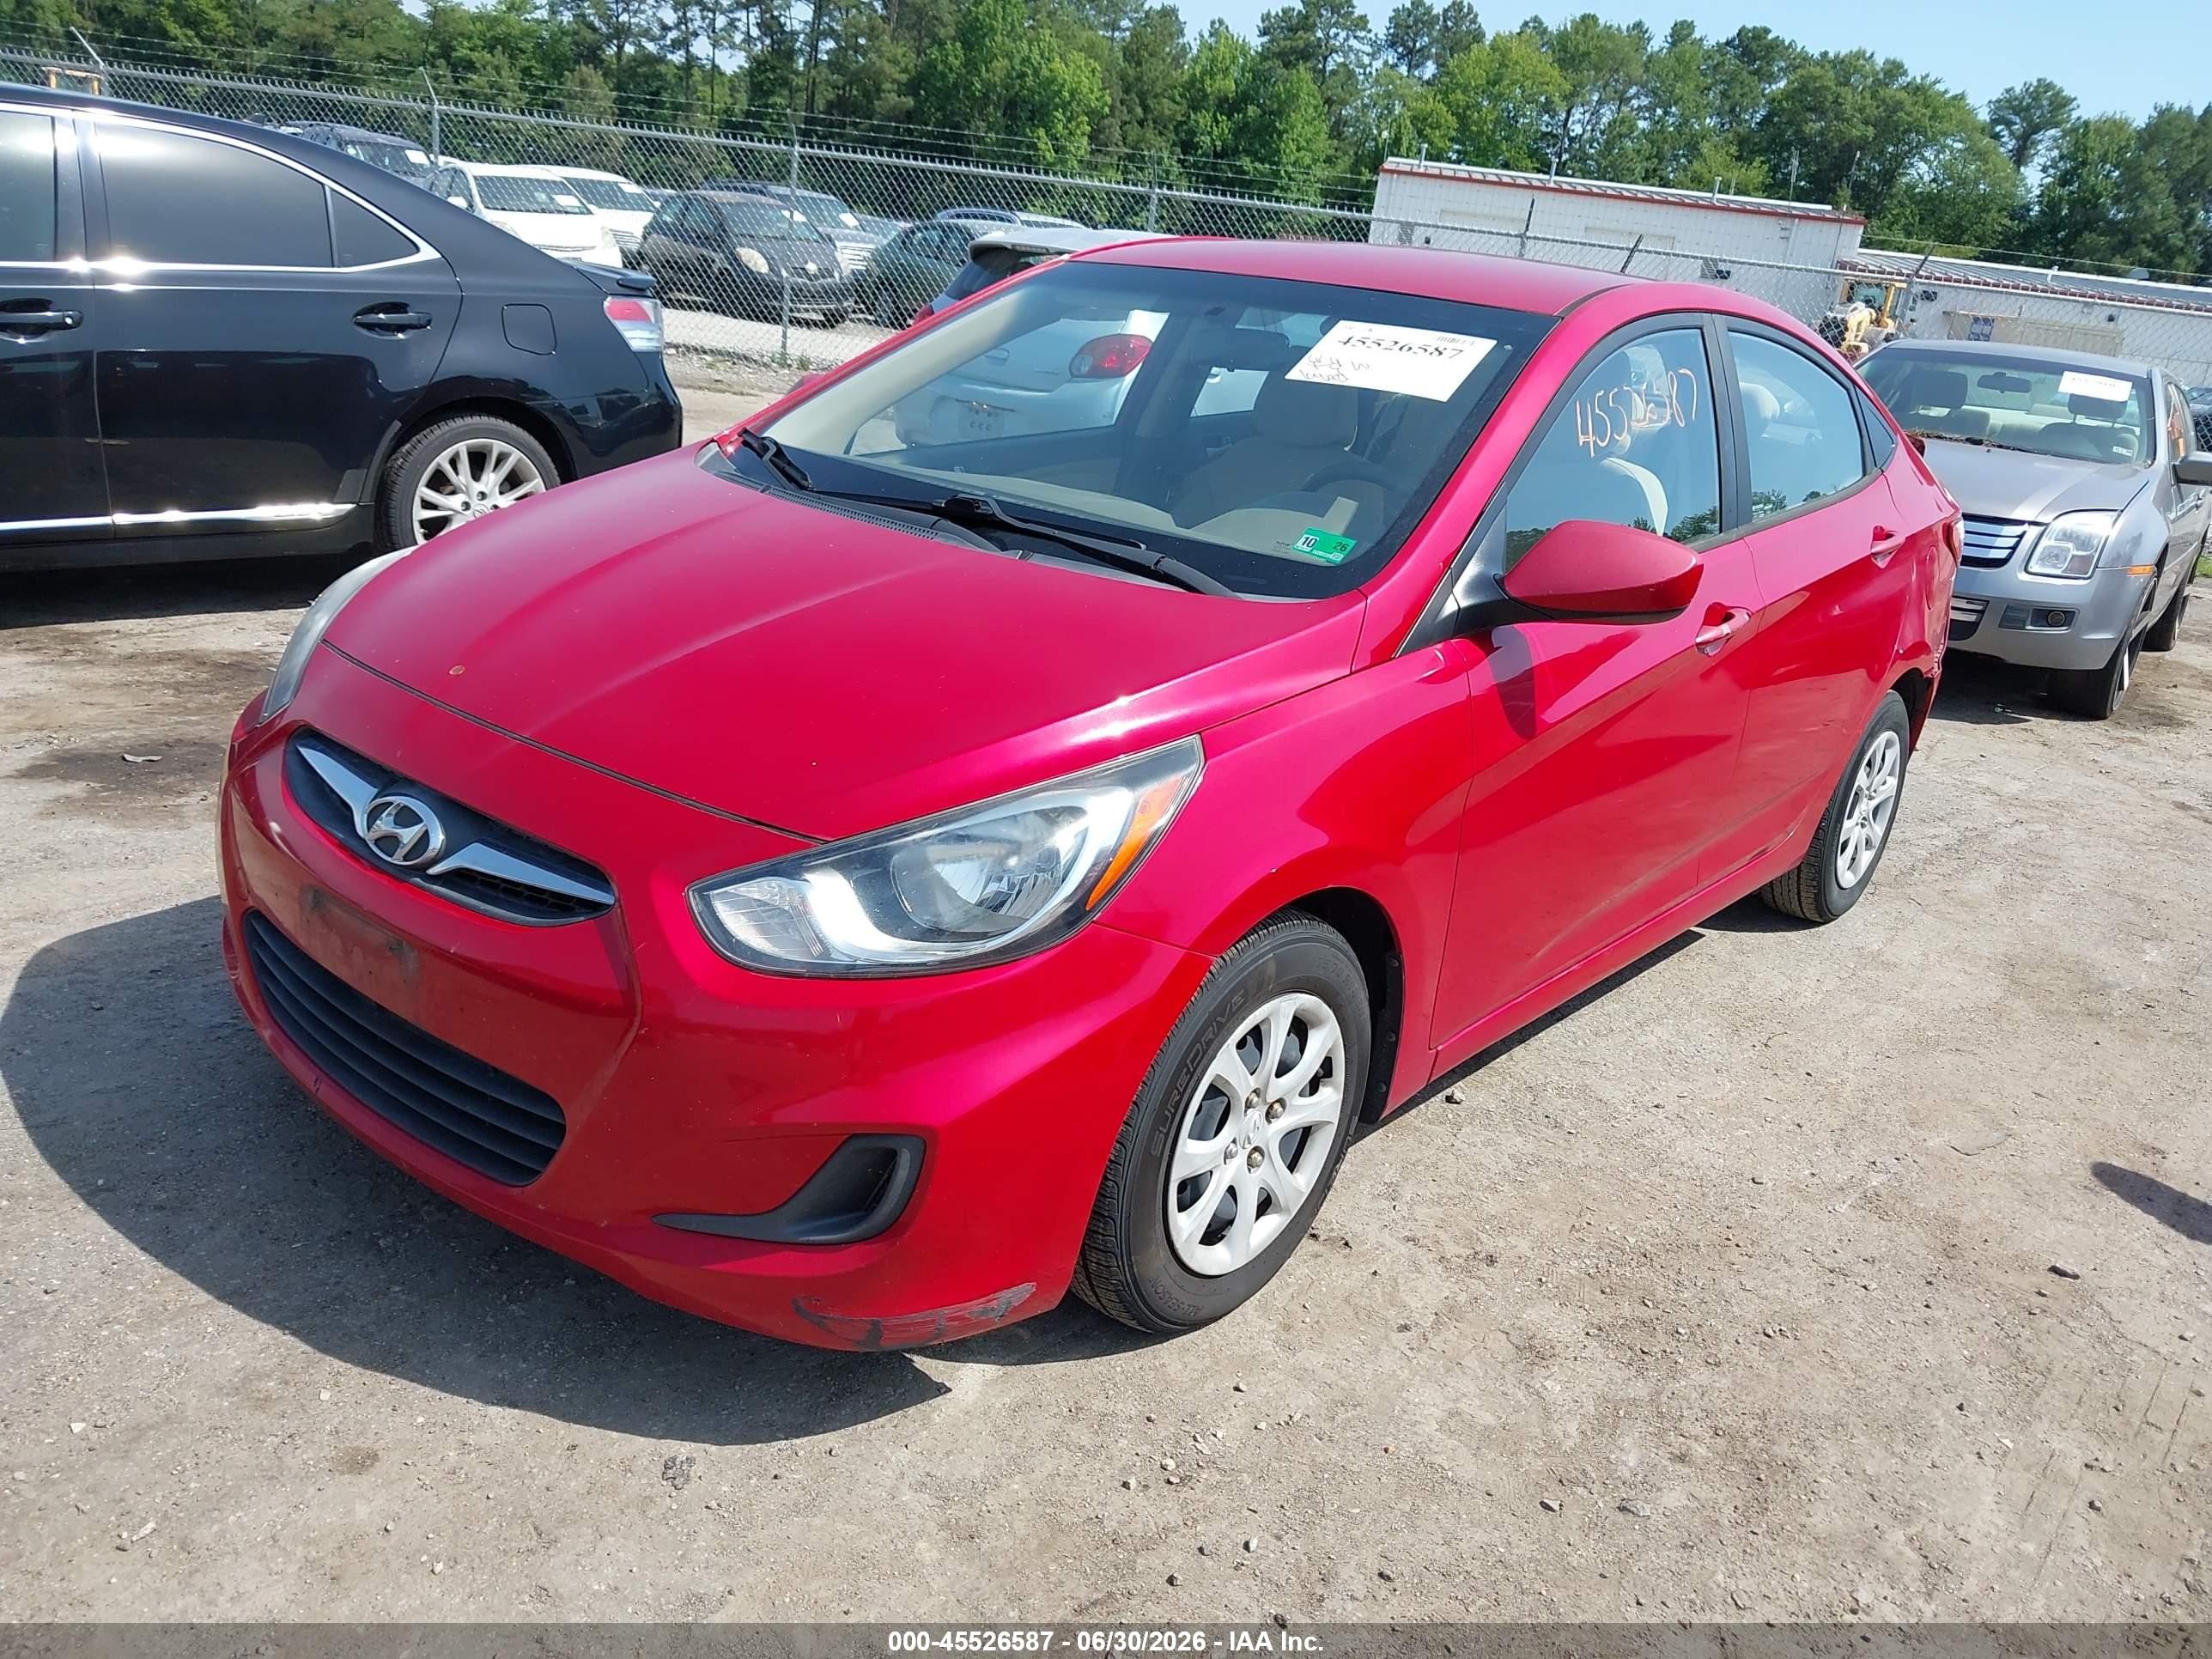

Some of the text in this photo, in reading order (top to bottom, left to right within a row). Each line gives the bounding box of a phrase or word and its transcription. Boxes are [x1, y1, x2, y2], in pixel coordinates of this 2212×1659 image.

[1337, 336, 1464, 359] 45526587
[1302, 536, 1317, 548] 10
[1334, 542, 1349, 552] 26
